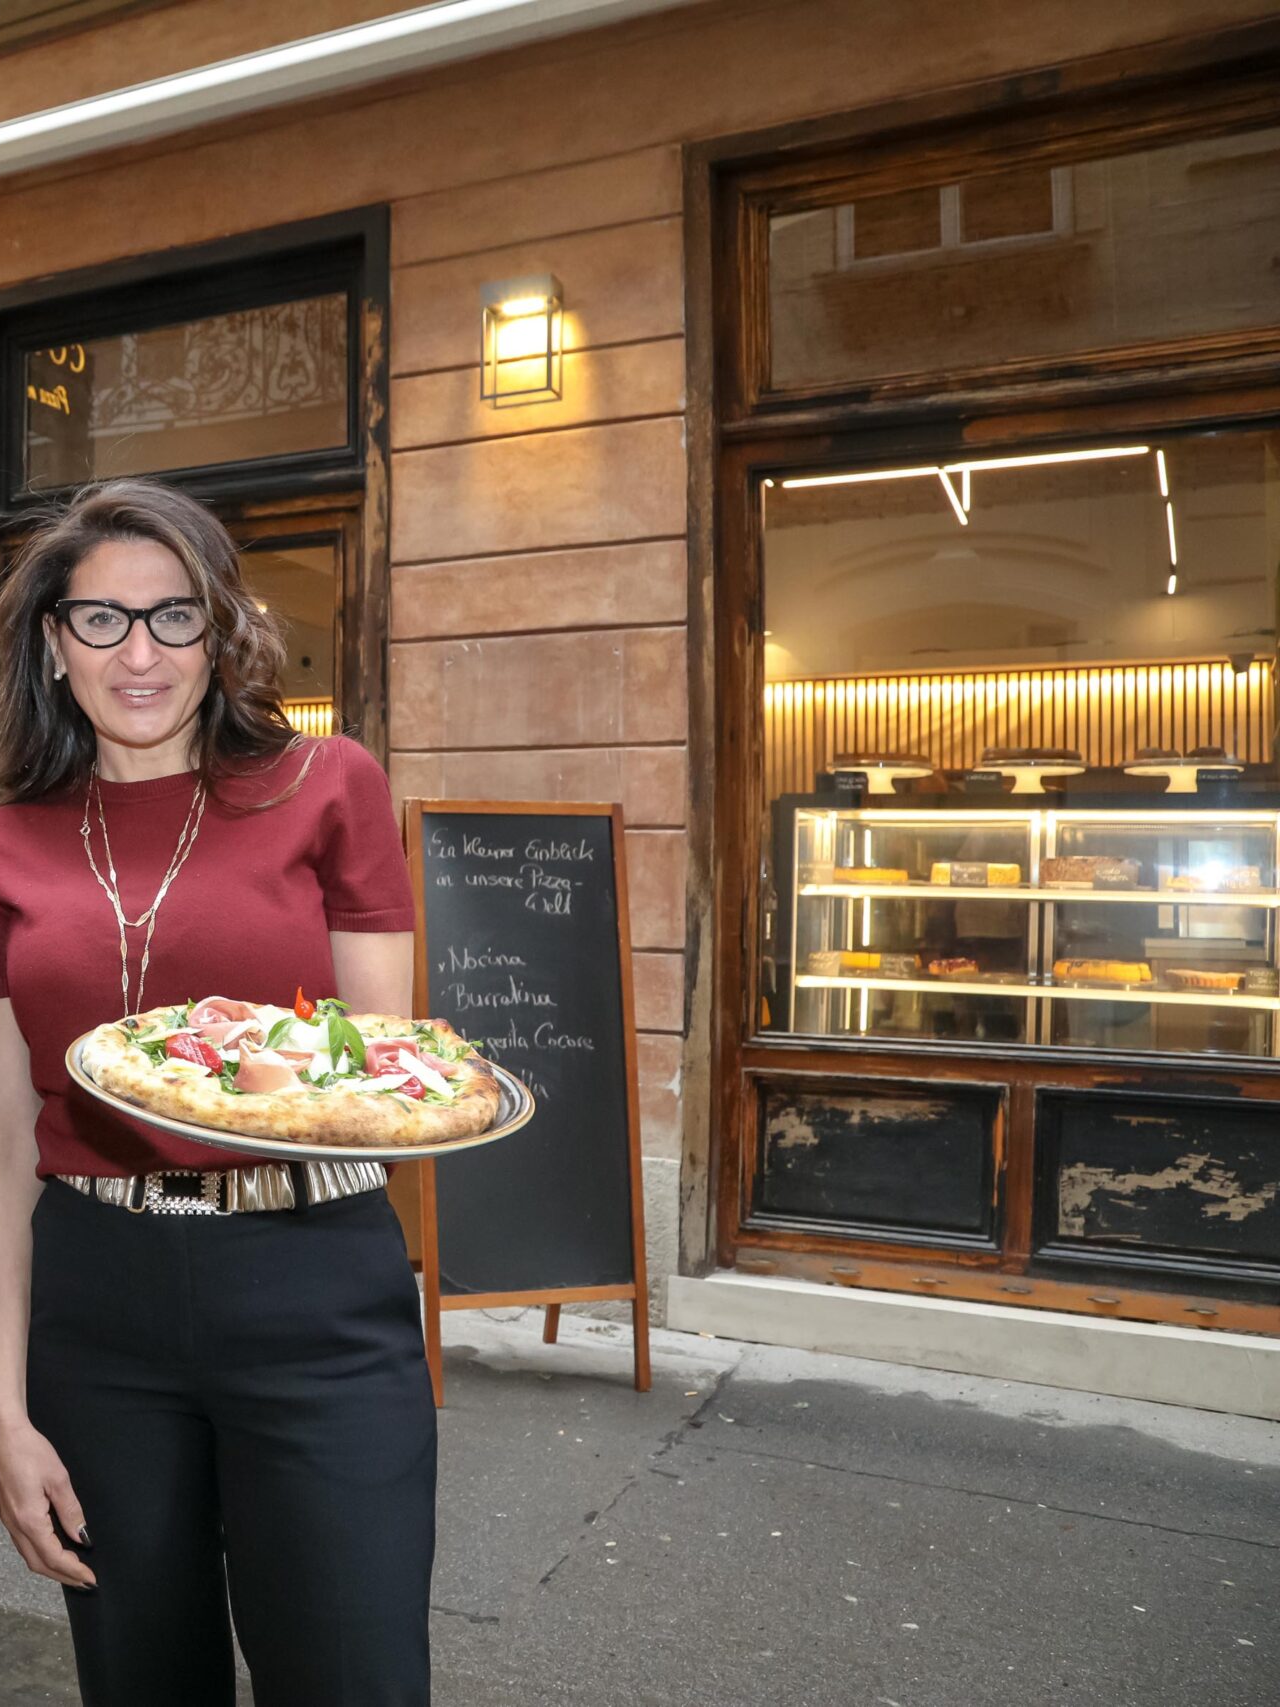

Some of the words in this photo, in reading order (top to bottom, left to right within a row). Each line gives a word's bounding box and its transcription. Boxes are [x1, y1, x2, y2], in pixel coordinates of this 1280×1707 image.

[428, 827, 457, 859] Ein
[525, 839, 594, 861] Einblick
[436, 871, 454, 888] in
[465, 874, 524, 889] unsere
[448, 974, 558, 1012] Burratina
